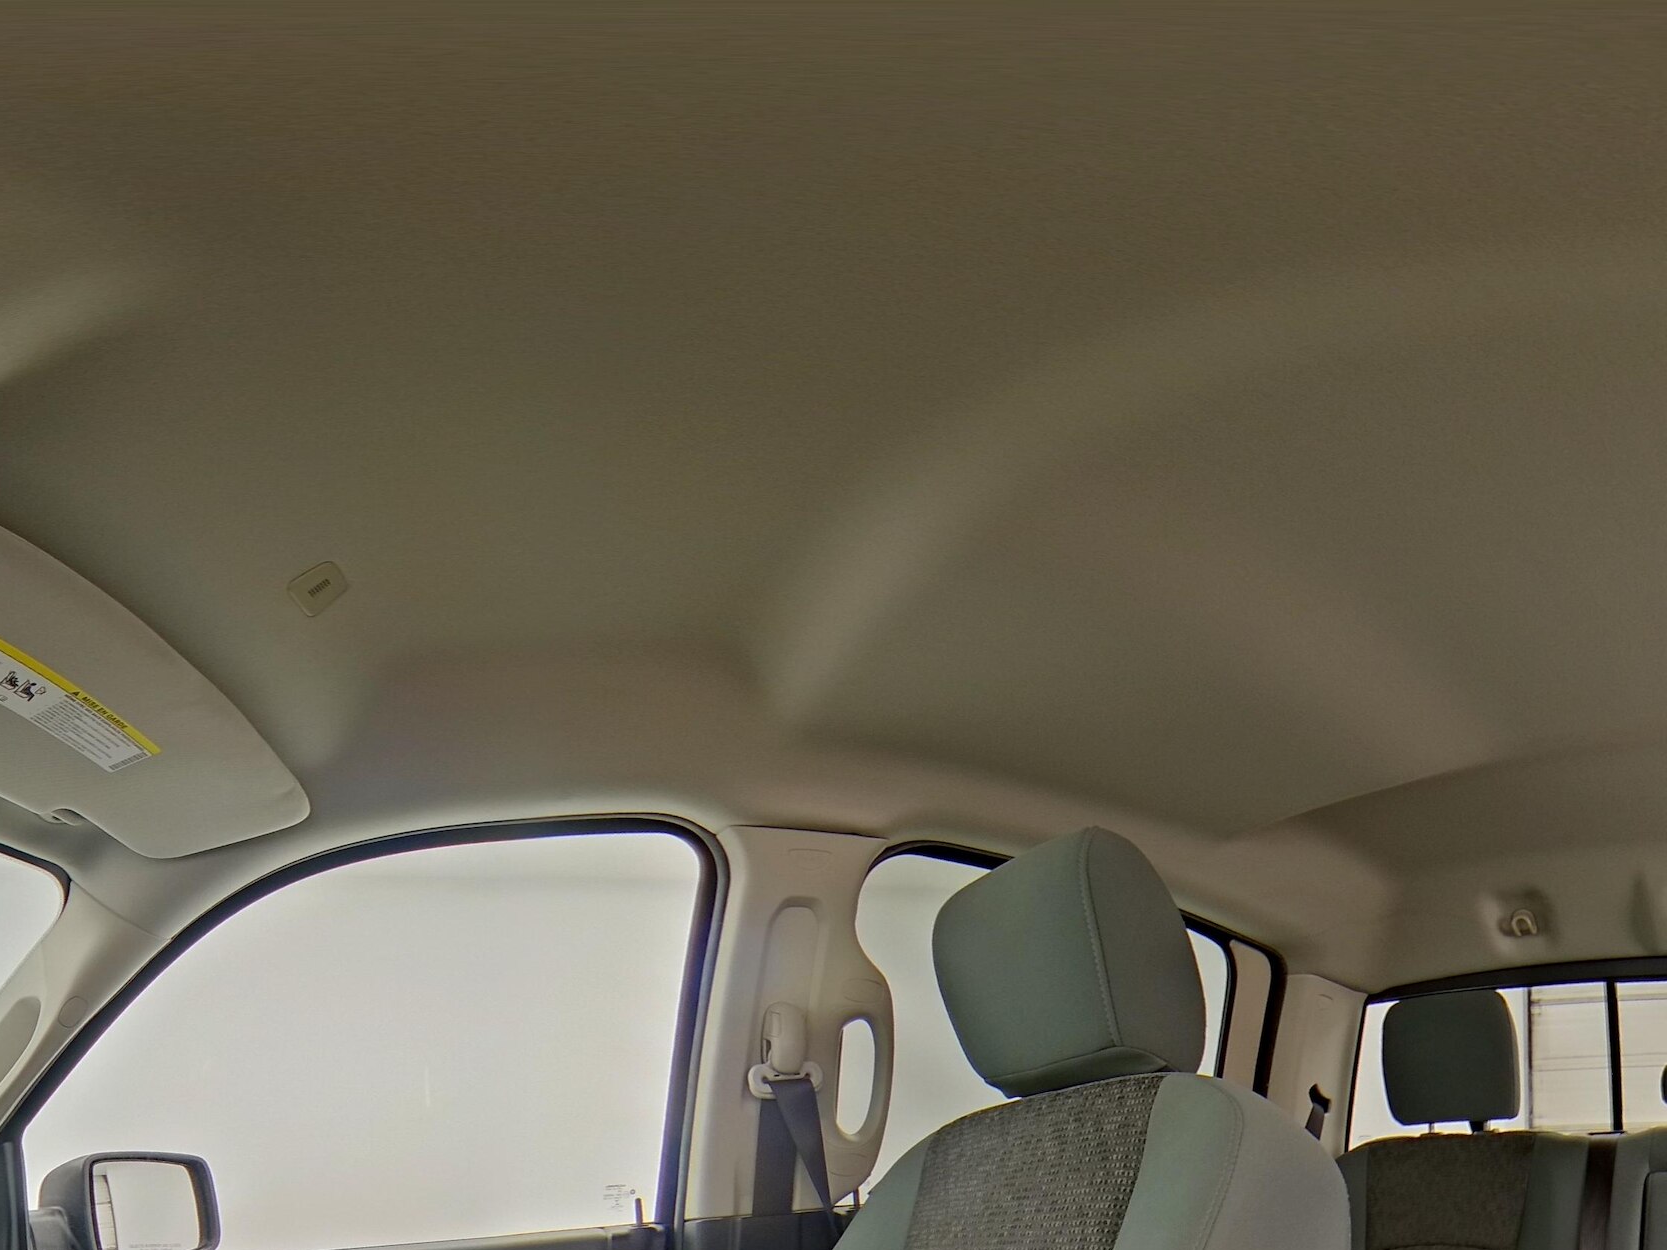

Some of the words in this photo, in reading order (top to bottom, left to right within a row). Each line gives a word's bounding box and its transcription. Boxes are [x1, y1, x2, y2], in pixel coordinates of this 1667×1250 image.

[82, 696, 98, 708] MISE
[97, 707, 107, 716] EN
[106, 714, 128, 729] GARDE
